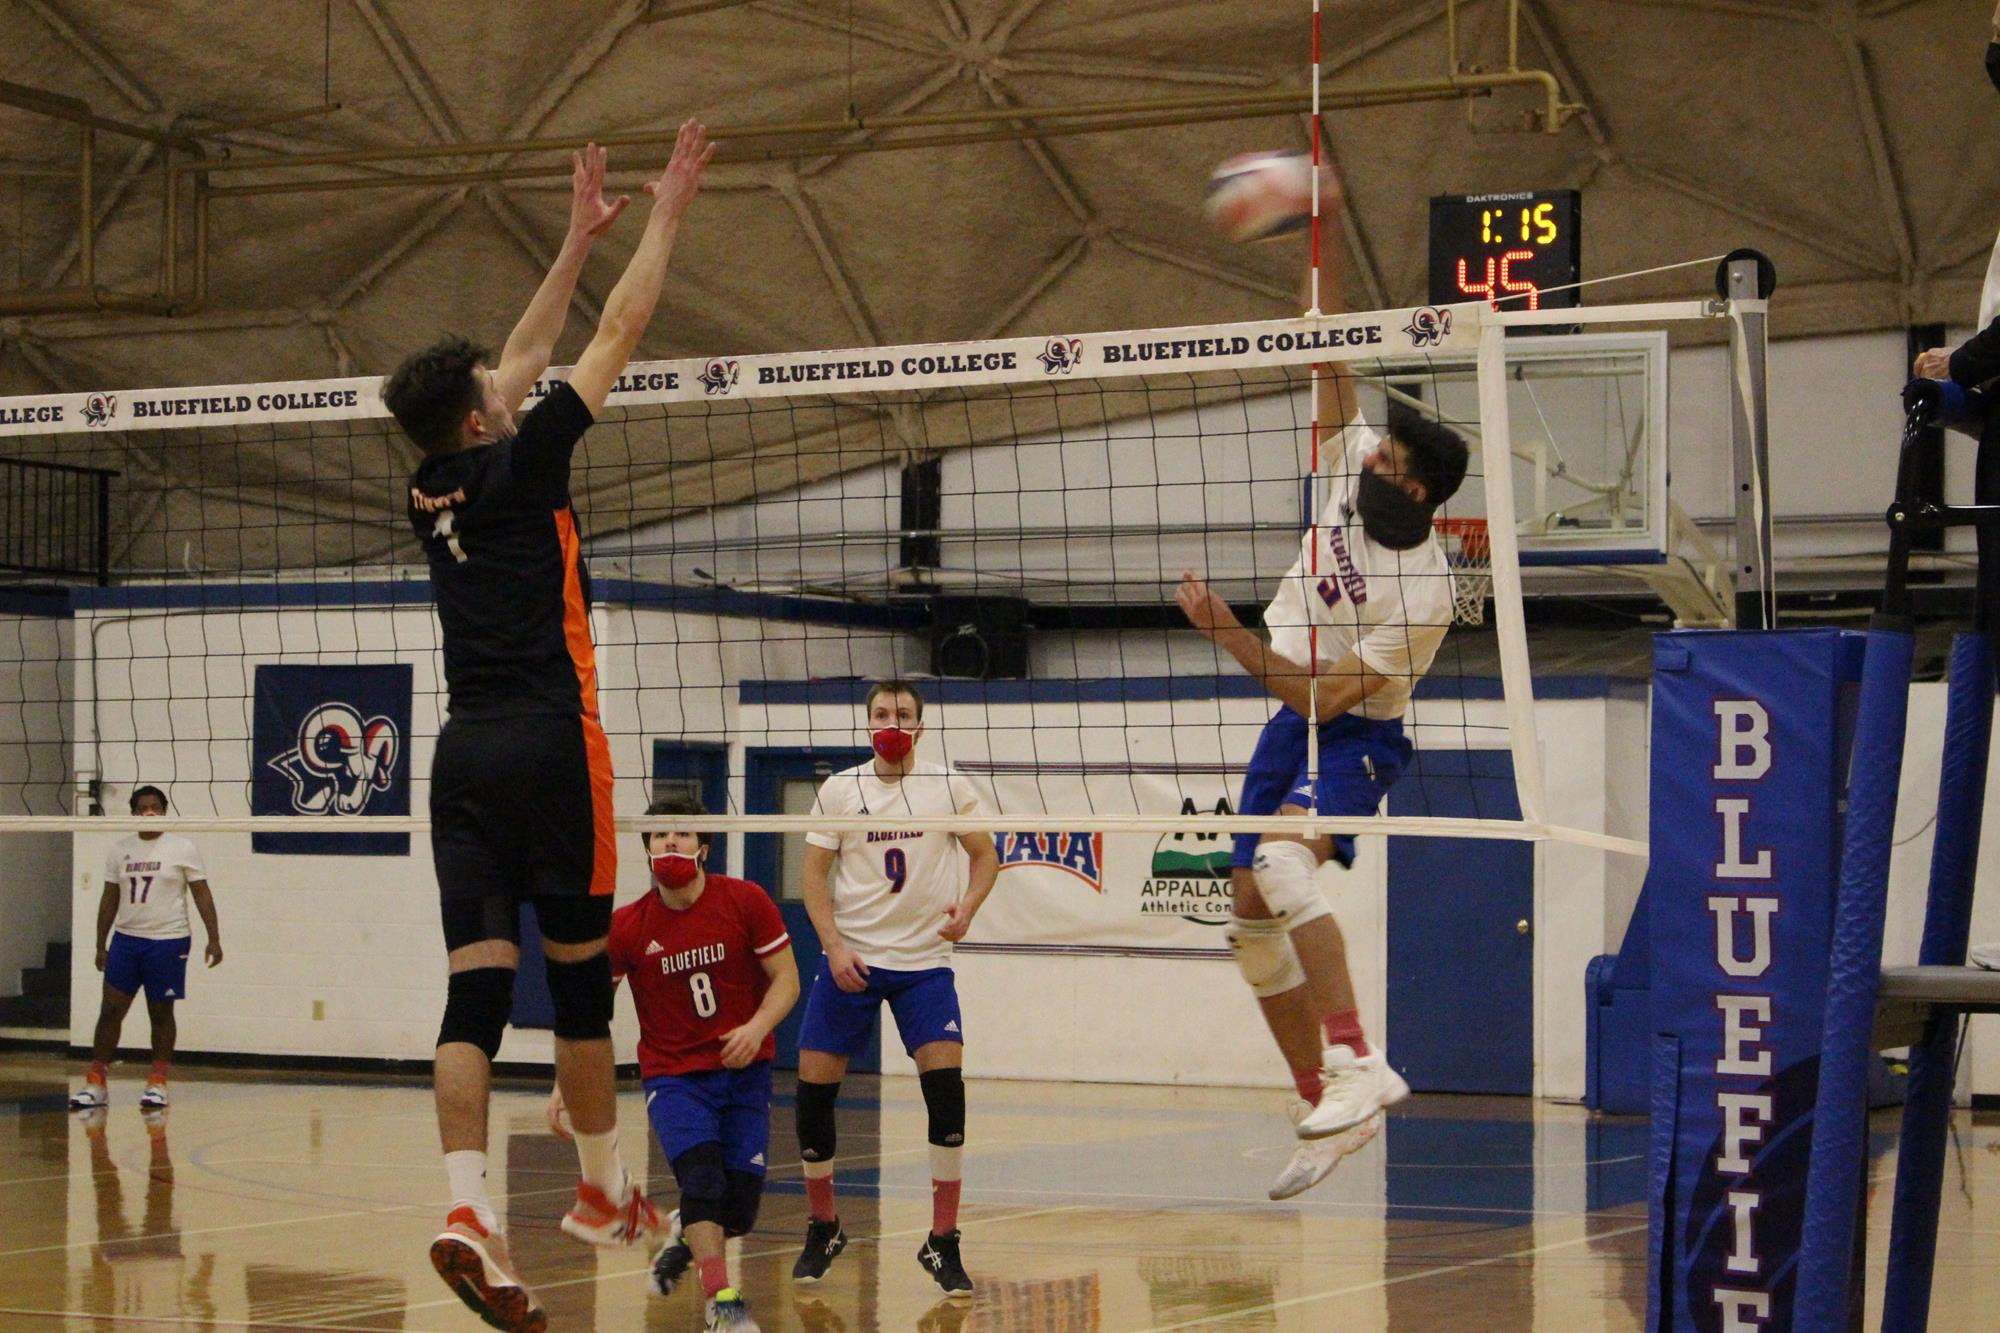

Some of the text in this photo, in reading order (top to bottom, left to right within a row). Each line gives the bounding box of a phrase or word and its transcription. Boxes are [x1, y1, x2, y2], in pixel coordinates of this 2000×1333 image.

[1466, 191, 1534, 203] DAKTRONICS
[1457, 250, 1538, 312] 45
[1103, 325, 1382, 364] BLUEFIELD COLLEGE
[758, 352, 1017, 385] BLUEFIELD COLLEGE
[133, 390, 358, 418] BLUEFIELD COLLEGE
[884, 847, 907, 894] 9
[129, 876, 154, 904] 17
[1141, 901, 1199, 913] Athletic
[661, 942, 725, 974] BLUEFIELD
[689, 971, 717, 1018] 8
